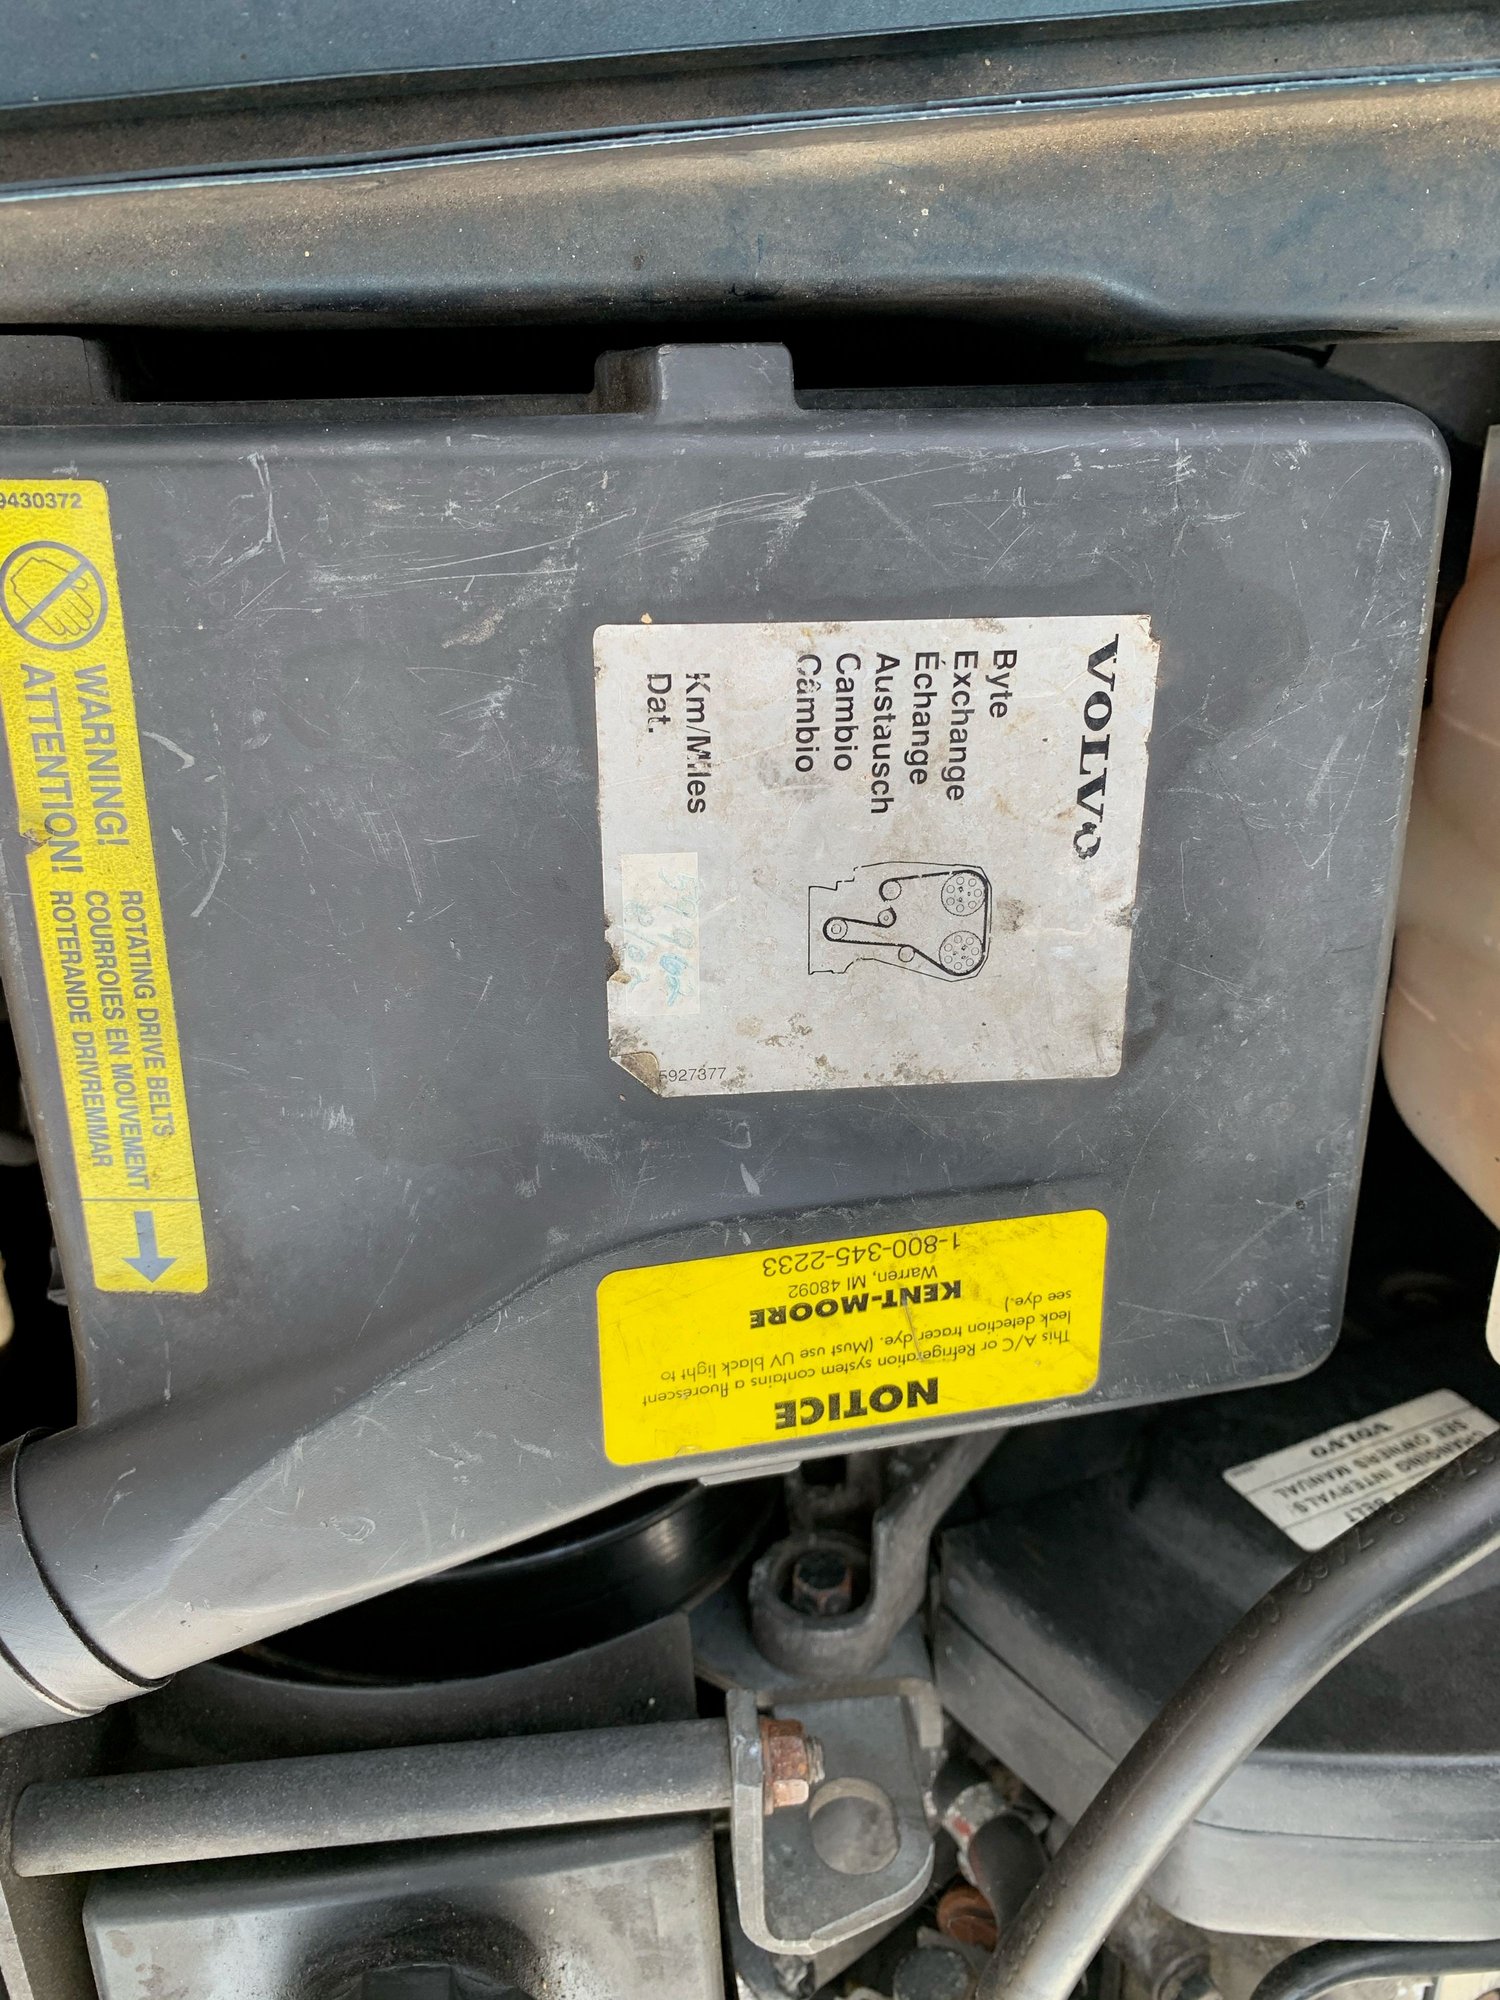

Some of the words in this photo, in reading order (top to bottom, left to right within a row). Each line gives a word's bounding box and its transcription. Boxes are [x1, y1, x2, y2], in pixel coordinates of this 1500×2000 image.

[985, 649, 1018, 719] Byte
[646, 673, 672, 734] Dat.
[795, 653, 823, 772] Câmbio
[833, 653, 862, 772] Cambio
[903, 652, 947, 786] Échange
[941, 650, 979, 802] Exchange
[685, 672, 712, 814] Km/Miles
[870, 652, 901, 814] Austausch
[74, 664, 130, 846] WARNING!
[1072, 633, 1120, 861] VOLVO
[20, 664, 85, 874] ATTENTION!
[85, 891, 126, 1021] COURROIES
[120, 891, 157, 1000] ROTATING
[50, 891, 92, 1024] ROTERANDE
[72, 1031, 113, 1167] DRIVREMMAR
[105, 1028, 131, 1055] EN
[136, 1008, 167, 1070] DRIVE
[146, 1077, 175, 1137] BELTS
[110, 1063, 149, 1190] MOUVEMENT
[762, 1231, 961, 1277] 1-800-345-2233
[847, 1274, 867, 1290] MI
[872, 1265, 938, 1284] Warren,
[788, 1278, 841, 1299] 48092
[1047, 1290, 1072, 1300] see
[750, 1279, 962, 1329] KENT-MOORE
[1004, 1293, 1043, 1313] dye.)
[967, 1314, 1036, 1336] detection
[1040, 1310, 1071, 1324] leak
[879, 1330, 913, 1344] dye.
[918, 1324, 962, 1341] tracer
[1001, 1334, 1037, 1352] A/C
[1042, 1330, 1070, 1344] This
[769, 1351, 795, 1367] UV
[799, 1346, 826, 1359] use
[830, 1337, 874, 1357] (Must
[878, 1343, 976, 1369] Refrigeration
[980, 1341, 998, 1352] or
[660, 1371, 676, 1382] to
[680, 1363, 717, 1383] light
[721, 1356, 765, 1372] black
[821, 1358, 873, 1377] system
[734, 1378, 745, 1389] a
[750, 1366, 816, 1389] contains
[642, 1382, 729, 1407] fluorescent
[774, 1377, 939, 1430] NOTICE
[1311, 1422, 1394, 1459] VOLVO
[1431, 1419, 1469, 1438] SEE
[1272, 1464, 1353, 1499] MANUAL
